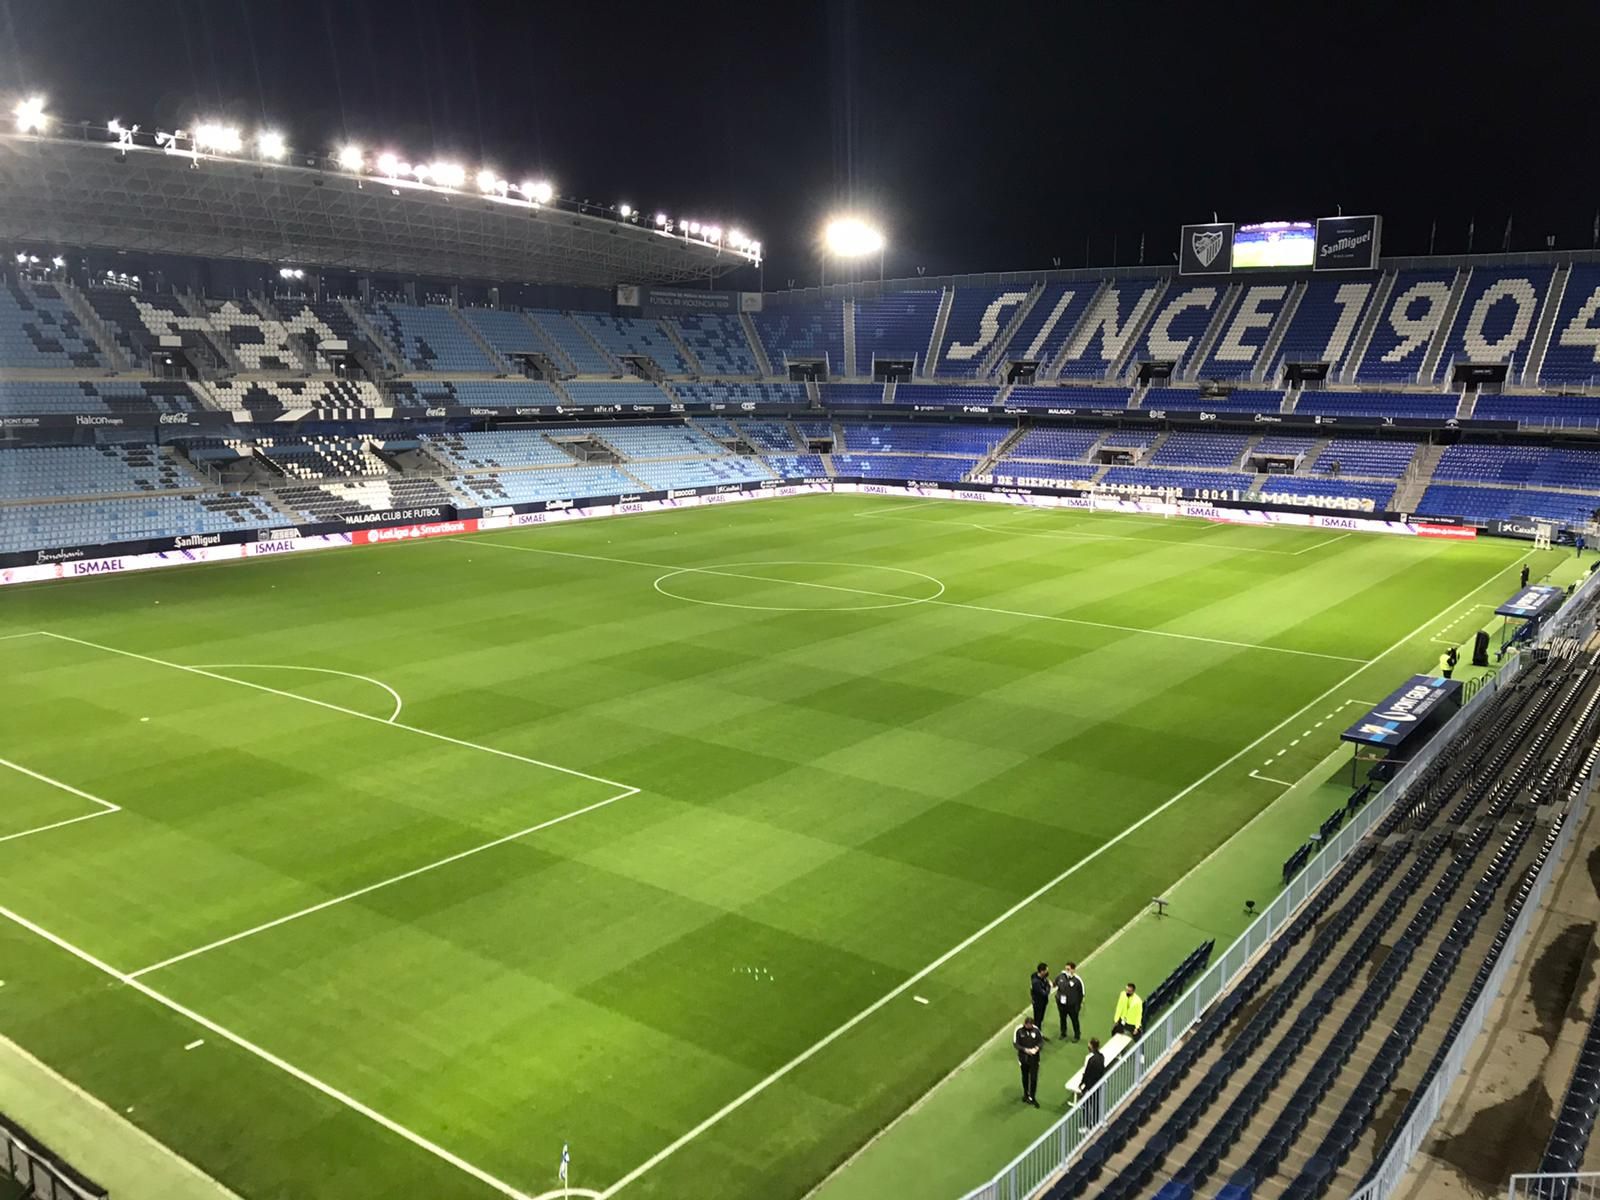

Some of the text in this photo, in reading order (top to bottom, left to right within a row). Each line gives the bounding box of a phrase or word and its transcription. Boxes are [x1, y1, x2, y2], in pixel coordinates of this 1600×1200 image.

[946, 285, 1287, 362] SINCE
[971, 474, 1074, 489] LOS DE SIEMPRE
[864, 486, 888, 494] ISMAEL
[959, 492, 986, 501] ISMAEL
[1110, 484, 1228, 500] FONDO SUR 1904
[1261, 492, 1361, 510] MALAKAS
[345, 507, 441, 524] MALAGA CLUB DE FUTBOL
[518, 513, 546, 524] ISMAEL
[1187, 507, 1220, 517] ISMAEL
[1321, 518, 1358, 528] ISMAEL
[173, 533, 221, 549] SanMiguel
[255, 540, 295, 554] ISMAEL
[74, 559, 125, 575] ISMAEL
